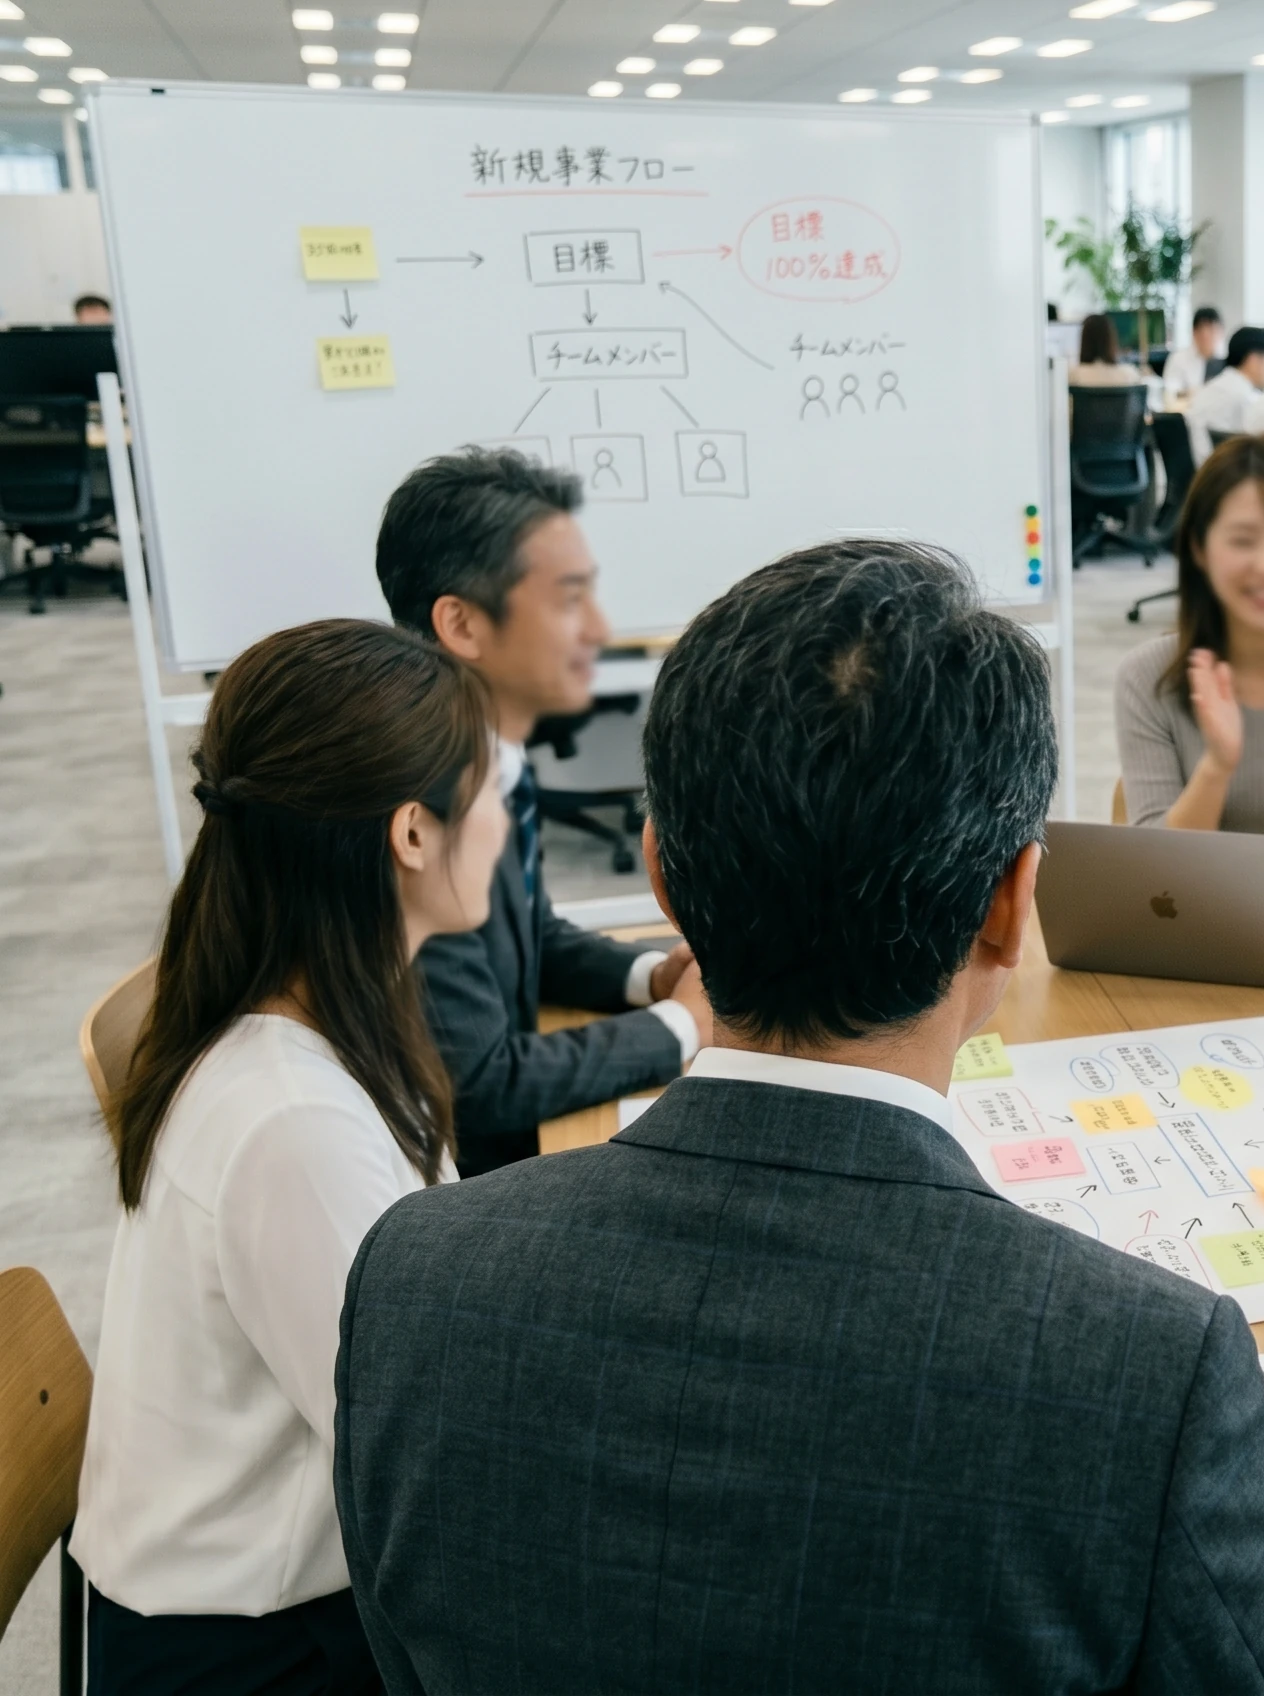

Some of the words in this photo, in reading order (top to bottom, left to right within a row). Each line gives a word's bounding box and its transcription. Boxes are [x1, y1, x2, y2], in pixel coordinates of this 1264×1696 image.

[470, 143, 696, 187] 新規事業フロー
[770, 210, 825, 243] 目標
[553, 238, 616, 275] 目標
[765, 249, 889, 282] 100%達成
[546, 340, 677, 371] チームメンバー
[788, 331, 906, 363] チームメンバー
